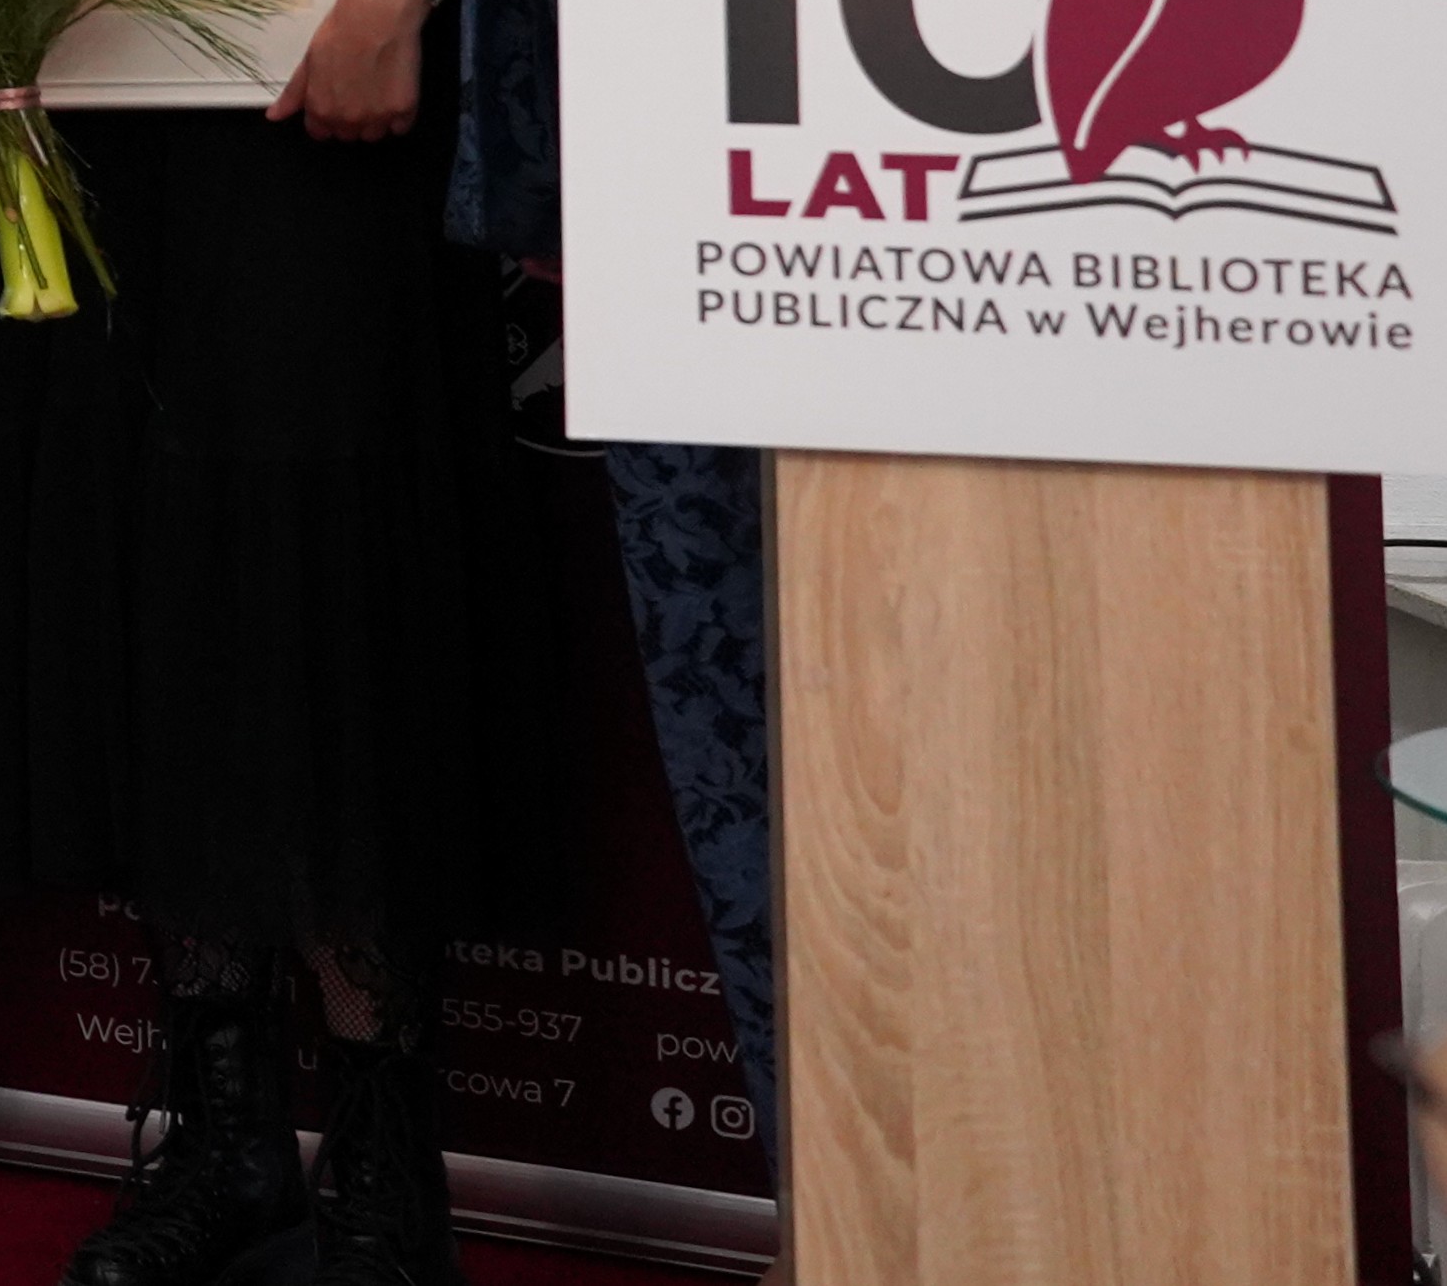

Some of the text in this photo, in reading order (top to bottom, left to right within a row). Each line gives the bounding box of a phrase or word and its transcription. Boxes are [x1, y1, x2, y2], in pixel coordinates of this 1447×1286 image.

[728, 149, 959, 221] LAT
[695, 239, 1413, 300] POWIATOWA BIBLIOTEKA
[697, 289, 1414, 353] PUBLICZNA w Wejherowie
[58, 948, 119, 987] (58)
